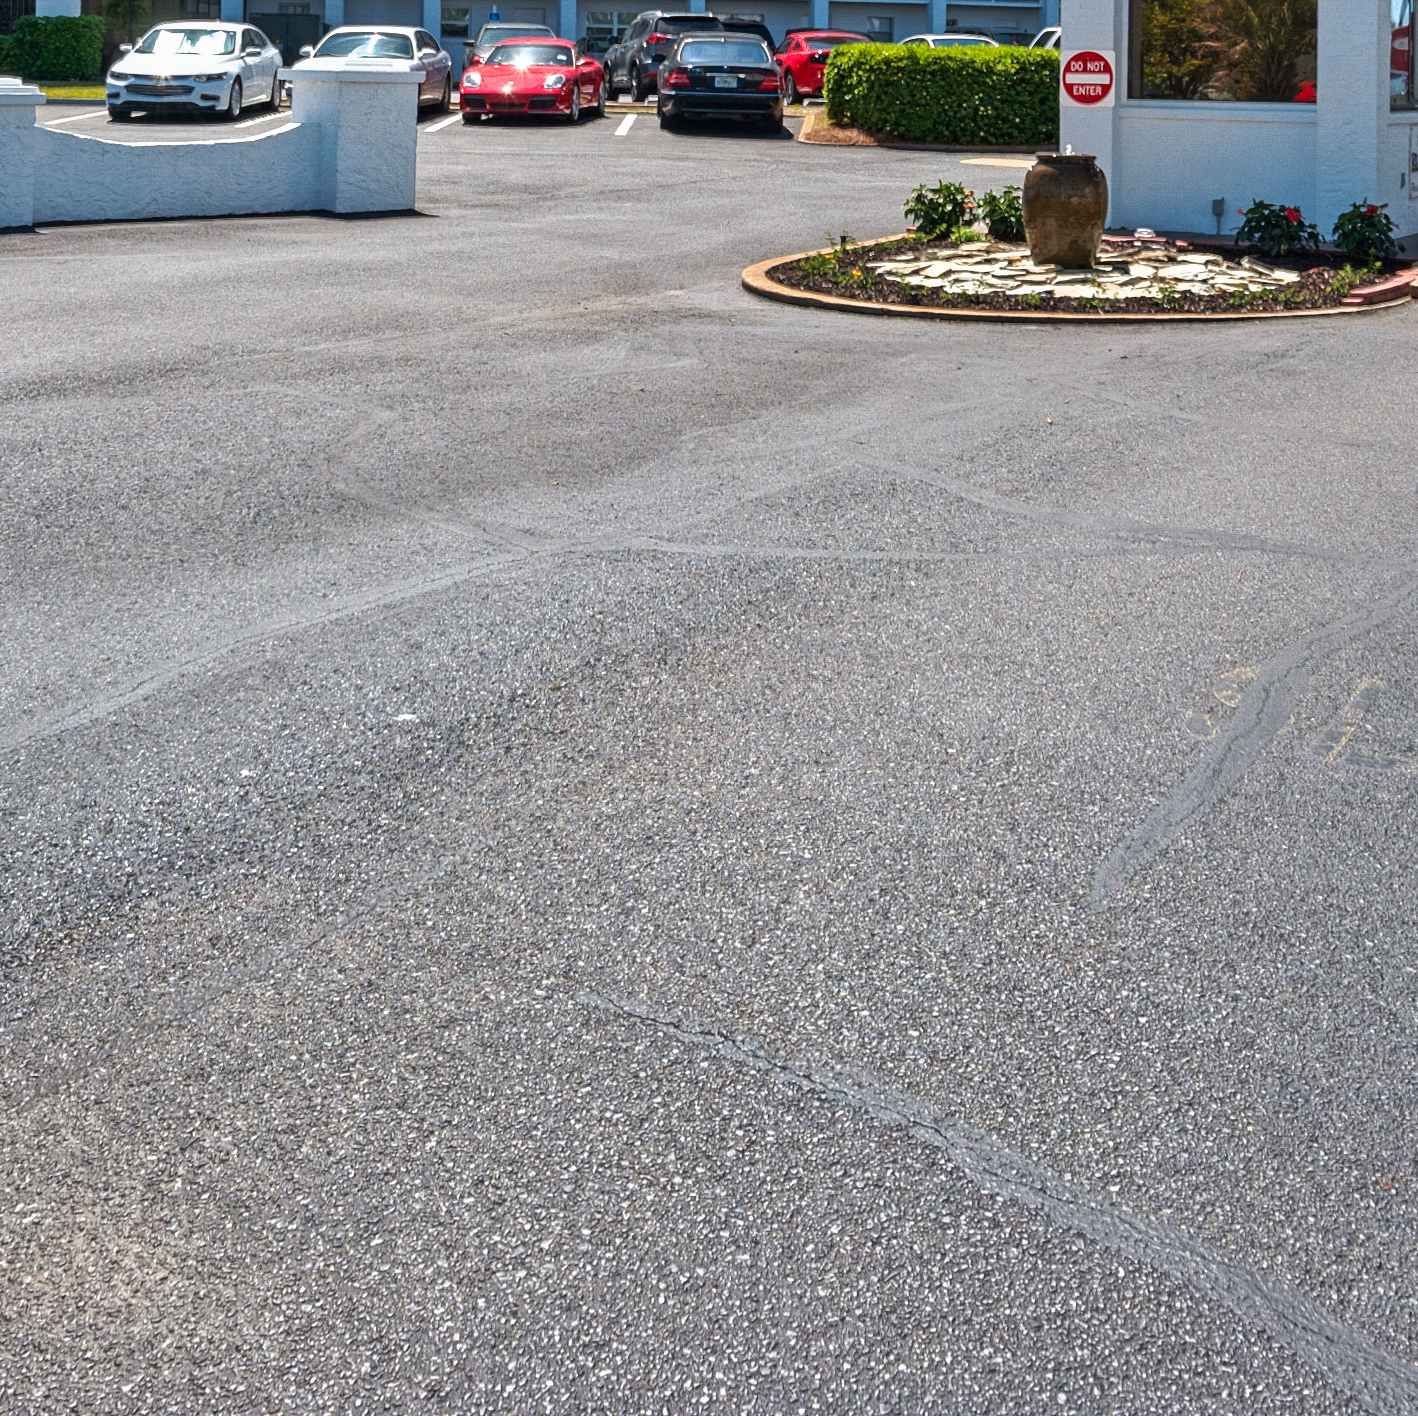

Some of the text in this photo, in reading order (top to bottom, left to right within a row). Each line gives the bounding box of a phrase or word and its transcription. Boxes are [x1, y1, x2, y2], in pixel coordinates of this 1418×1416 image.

[1070, 60, 1105, 71] DO NOT
[1073, 85, 1102, 96] ENTER
